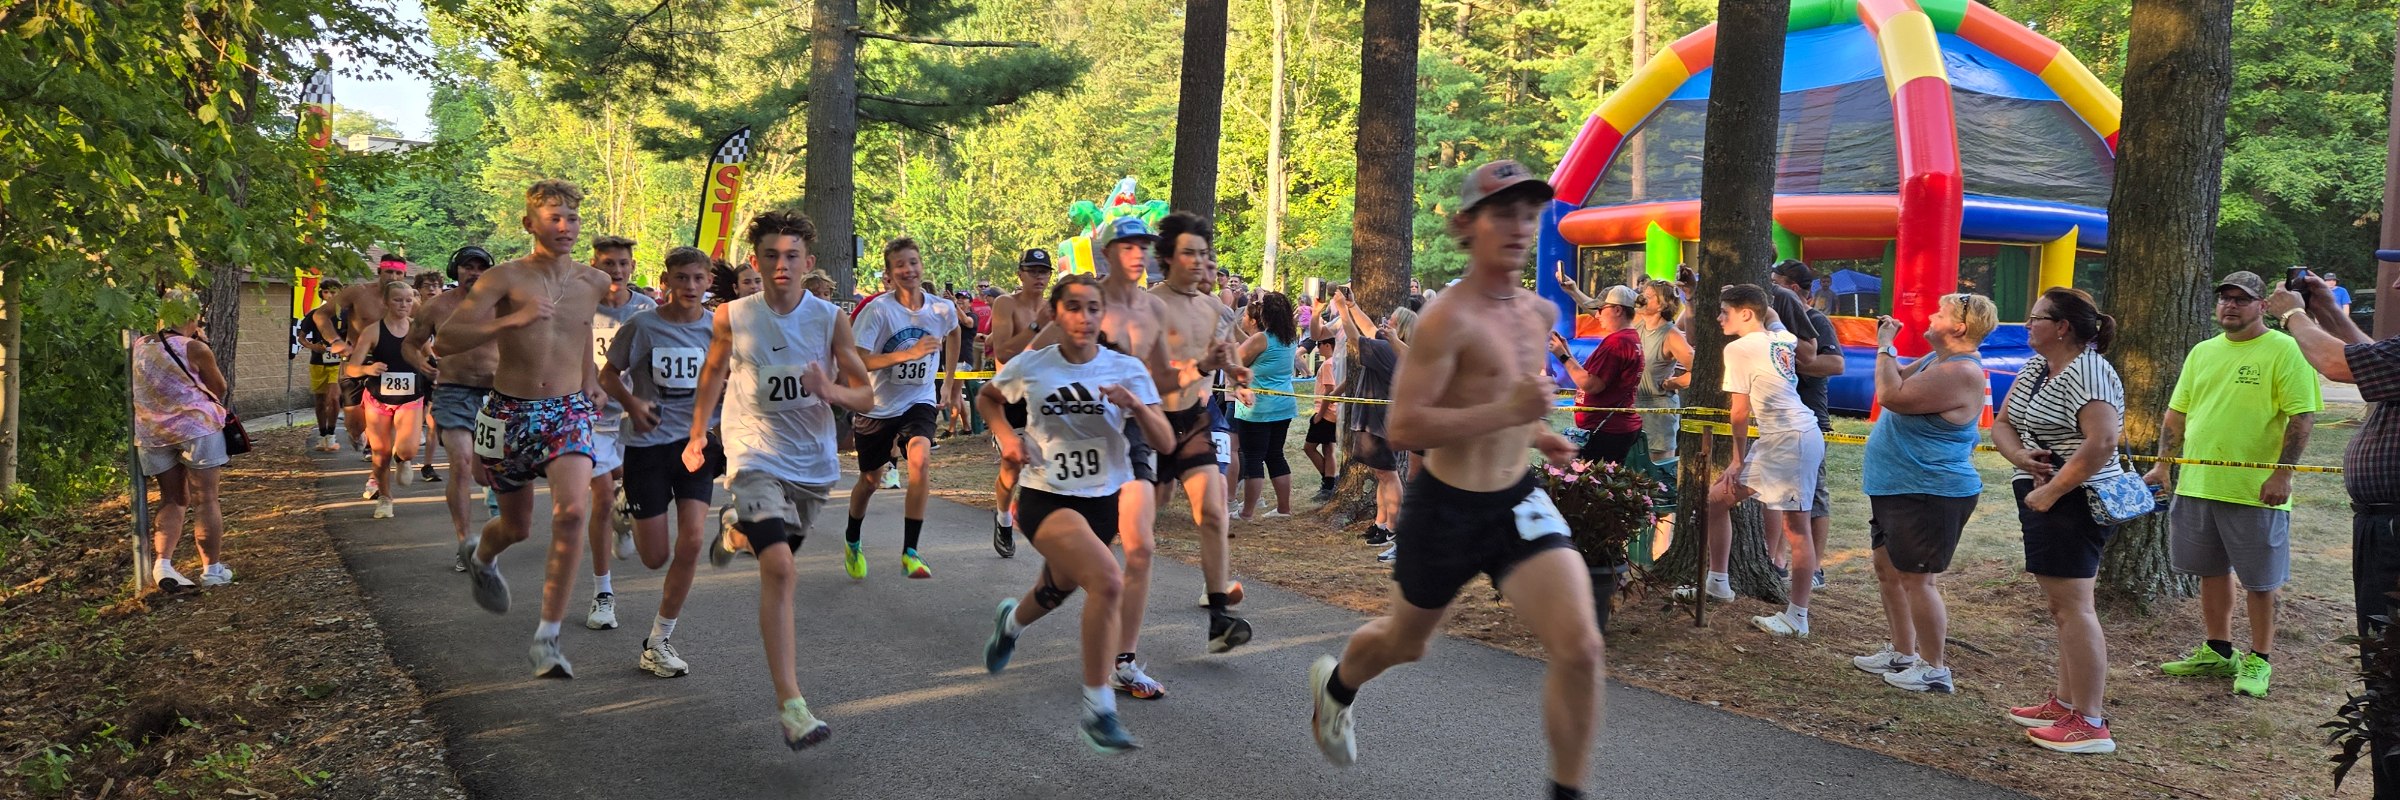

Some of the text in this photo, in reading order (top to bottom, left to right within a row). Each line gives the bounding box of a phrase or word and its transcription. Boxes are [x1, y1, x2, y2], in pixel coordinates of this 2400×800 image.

[661, 356, 698, 379] 315
[898, 362, 926, 379] 336
[386, 377, 410, 391] 283
[1041, 400, 1105, 416] adidas
[1053, 448, 1100, 481] 339
